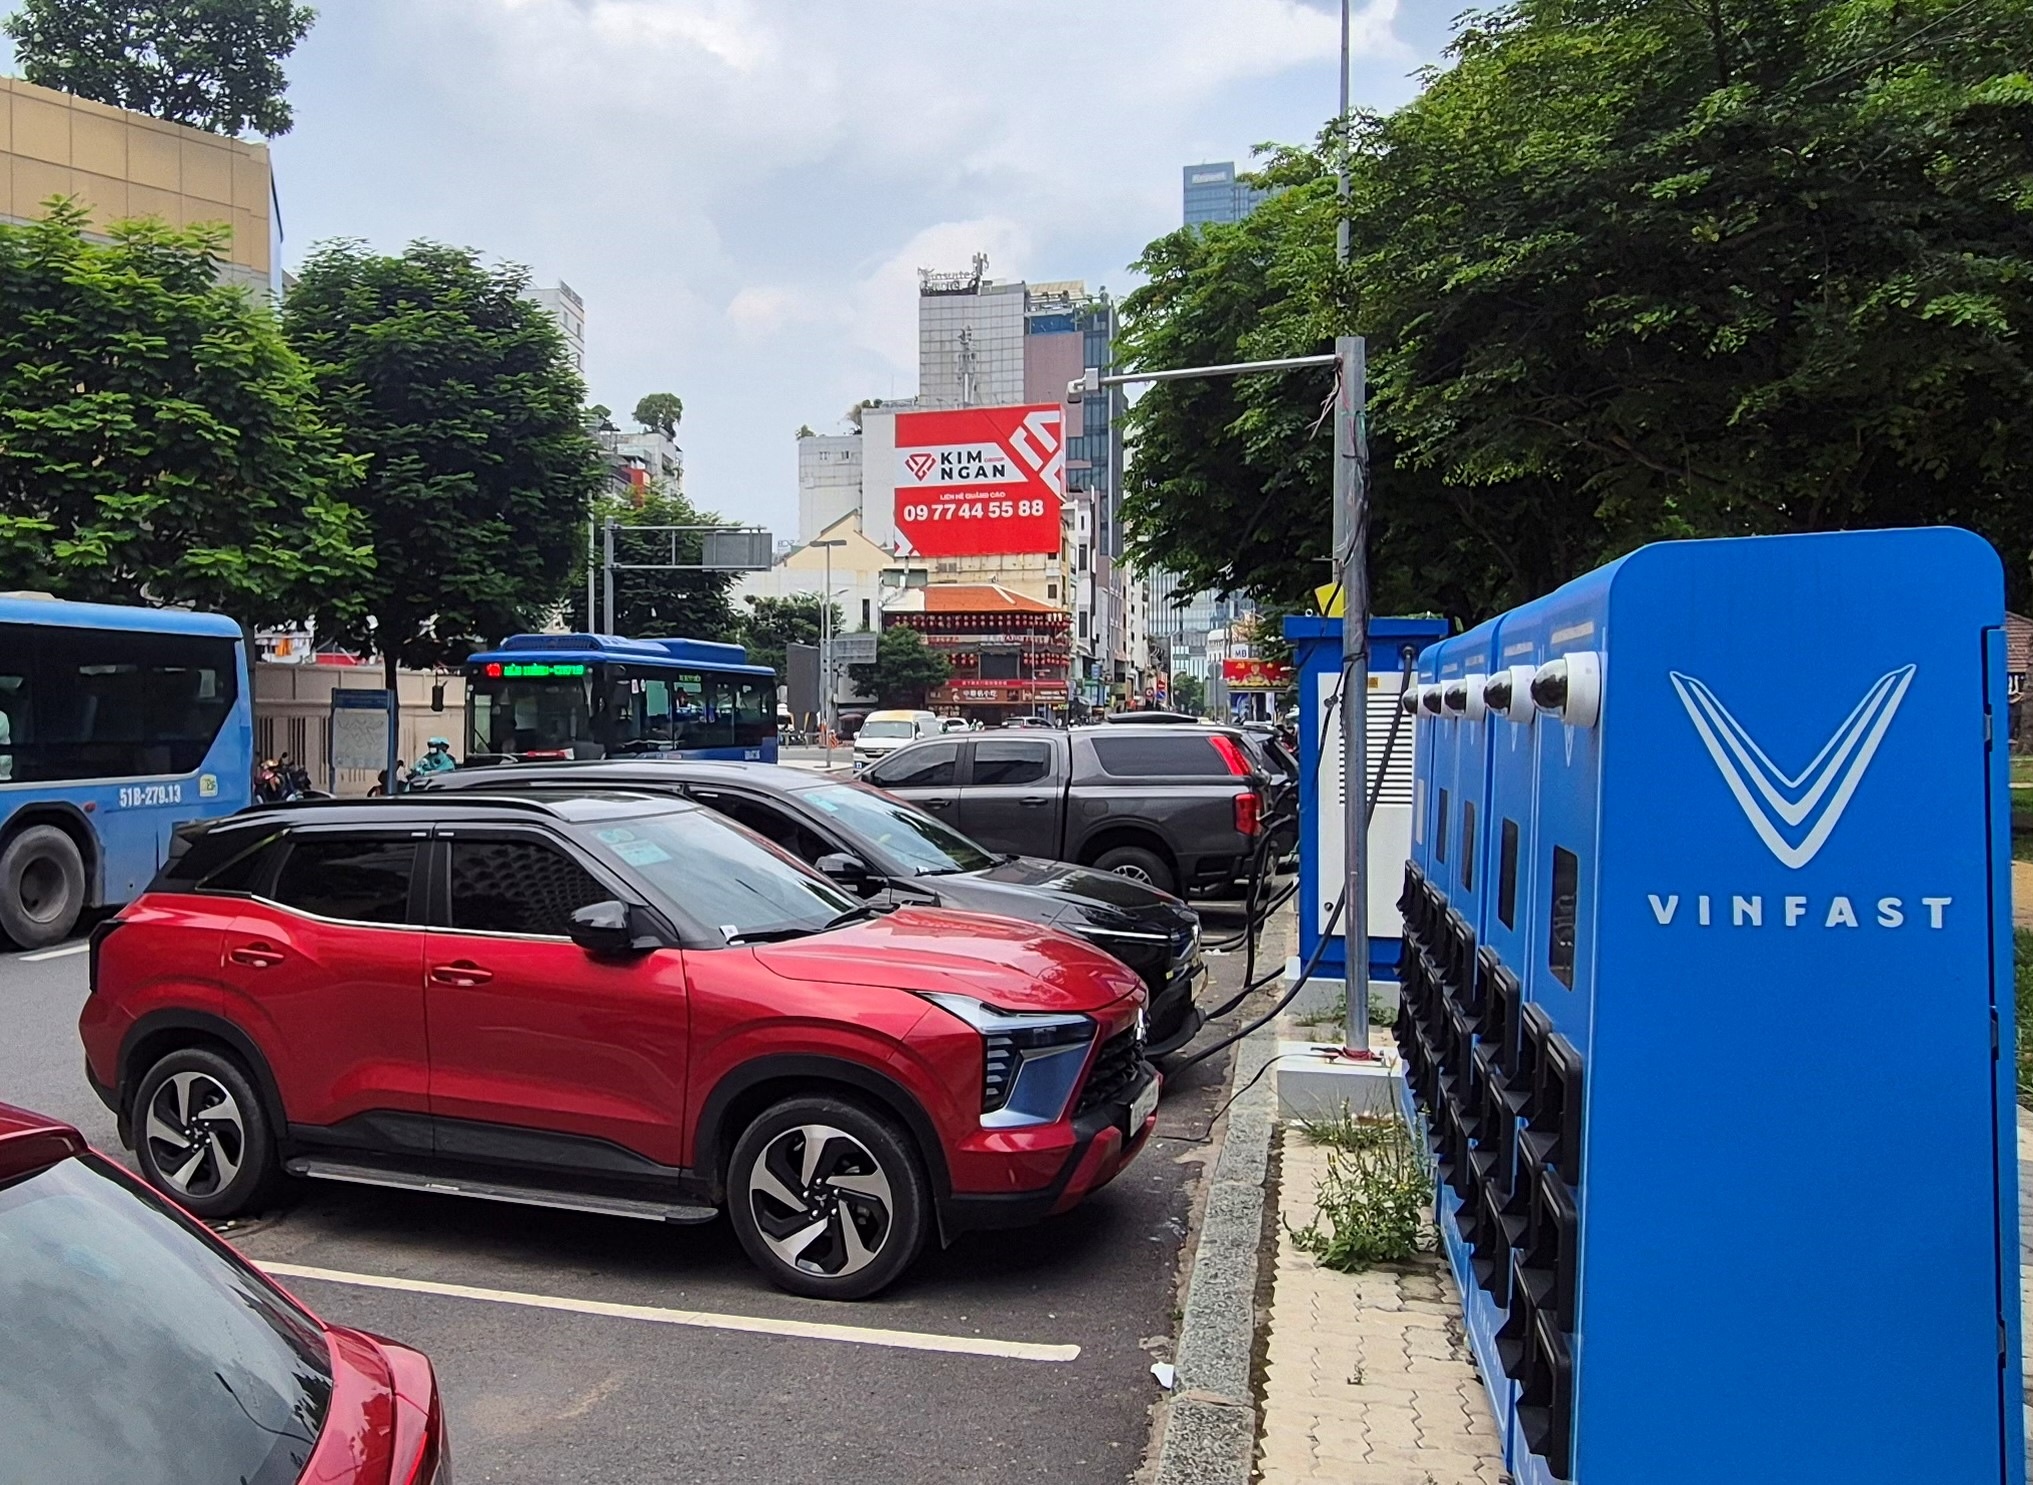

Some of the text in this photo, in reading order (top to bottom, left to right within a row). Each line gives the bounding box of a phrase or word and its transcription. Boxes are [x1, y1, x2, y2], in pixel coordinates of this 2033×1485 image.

[940, 450, 982, 465] KIM
[940, 464, 1005, 480] NGAN
[904, 499, 1044, 522] 09 77 44 55 88
[119, 784, 181, 808] 51B-279.13
[1648, 894, 1952, 929] VINFAST
